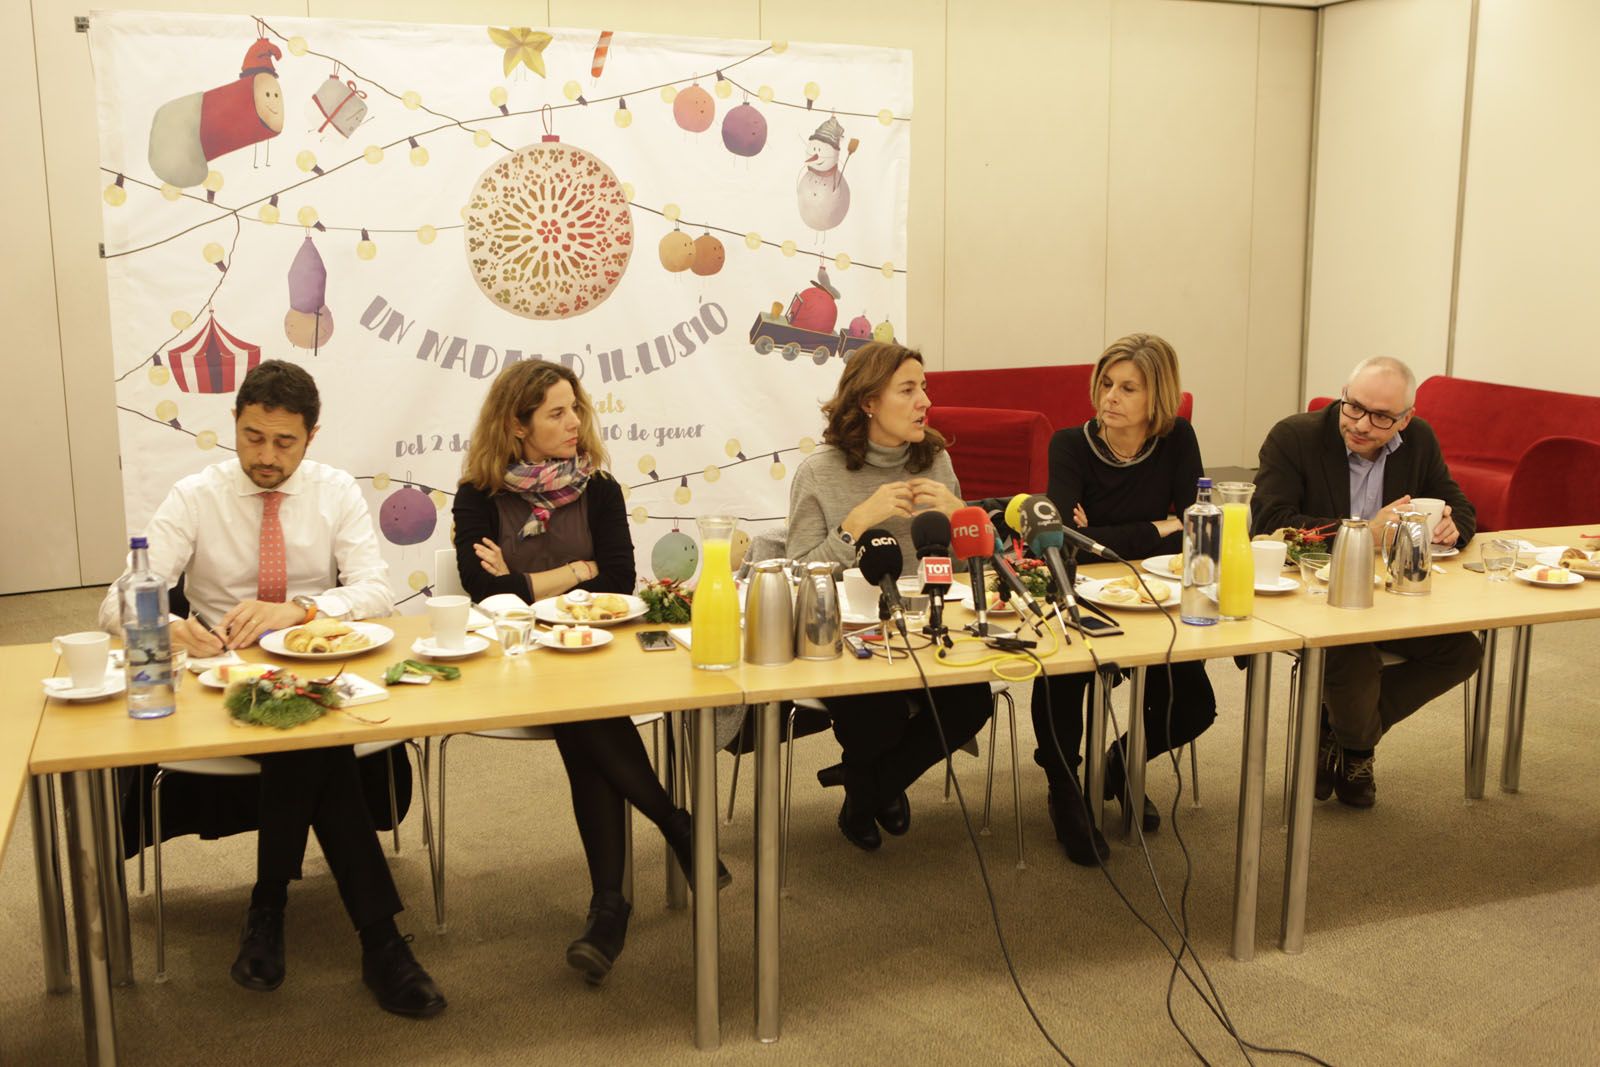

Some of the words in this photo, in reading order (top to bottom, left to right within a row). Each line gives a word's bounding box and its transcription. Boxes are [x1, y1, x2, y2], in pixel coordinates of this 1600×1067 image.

[360, 295, 416, 345] UN
[416, 328, 543, 380] NAD
[395, 434, 427, 458] Del
[431, 434, 443, 452] 2
[627, 423, 650, 441] de
[653, 423, 705, 448] gener
[953, 524, 980, 538] rne
[871, 536, 898, 547] acn
[926, 563, 951, 575] TOT
